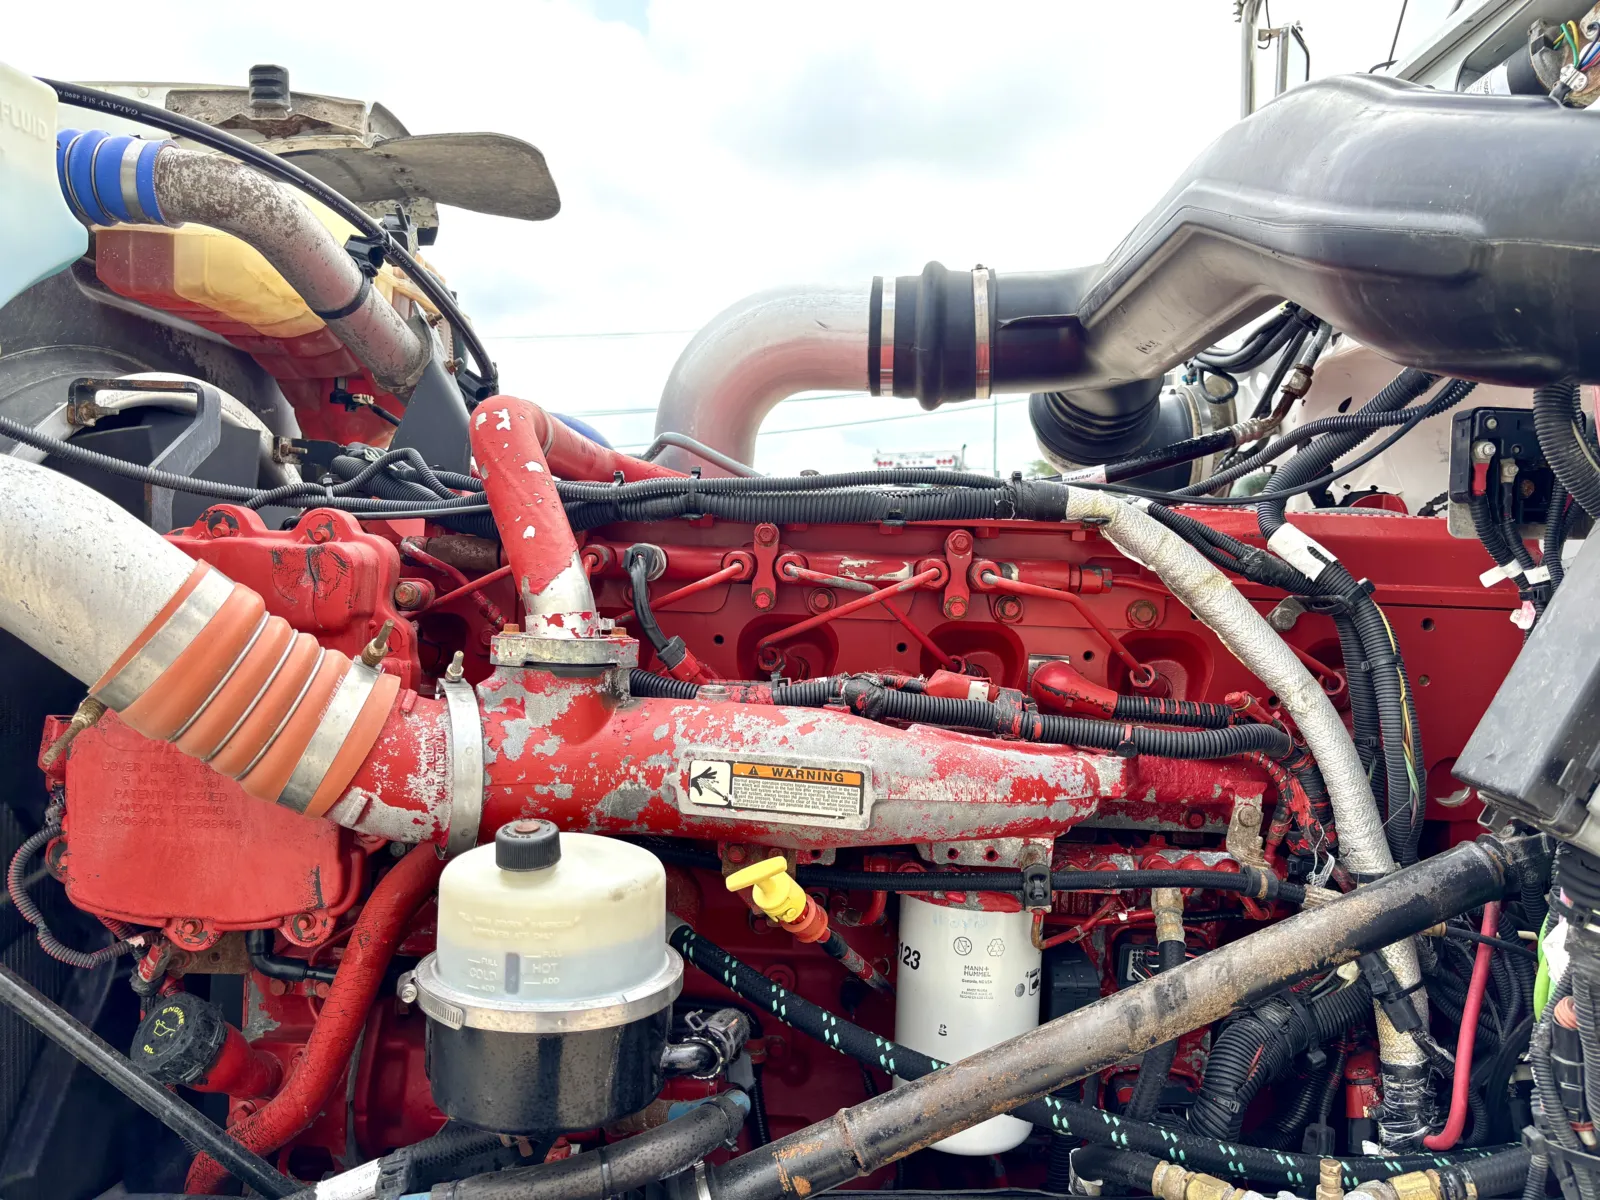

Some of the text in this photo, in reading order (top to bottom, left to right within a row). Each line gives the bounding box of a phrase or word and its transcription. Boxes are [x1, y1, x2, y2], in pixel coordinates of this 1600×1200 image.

[82, 94, 96, 105] SLE
[98, 100, 139, 116] GALAXY
[0, 102, 48, 140] FLUID
[101, 760, 142, 773] COVER
[150, 761, 182, 774] BOLT
[772, 767, 844, 783] WARNING
[117, 802, 163, 814] AND/OR
[469, 962, 558, 981] COLD HOT
[542, 977, 560, 985] ADD
[162, 1006, 185, 1025] ENGINE
[143, 1044, 155, 1054] OIL
